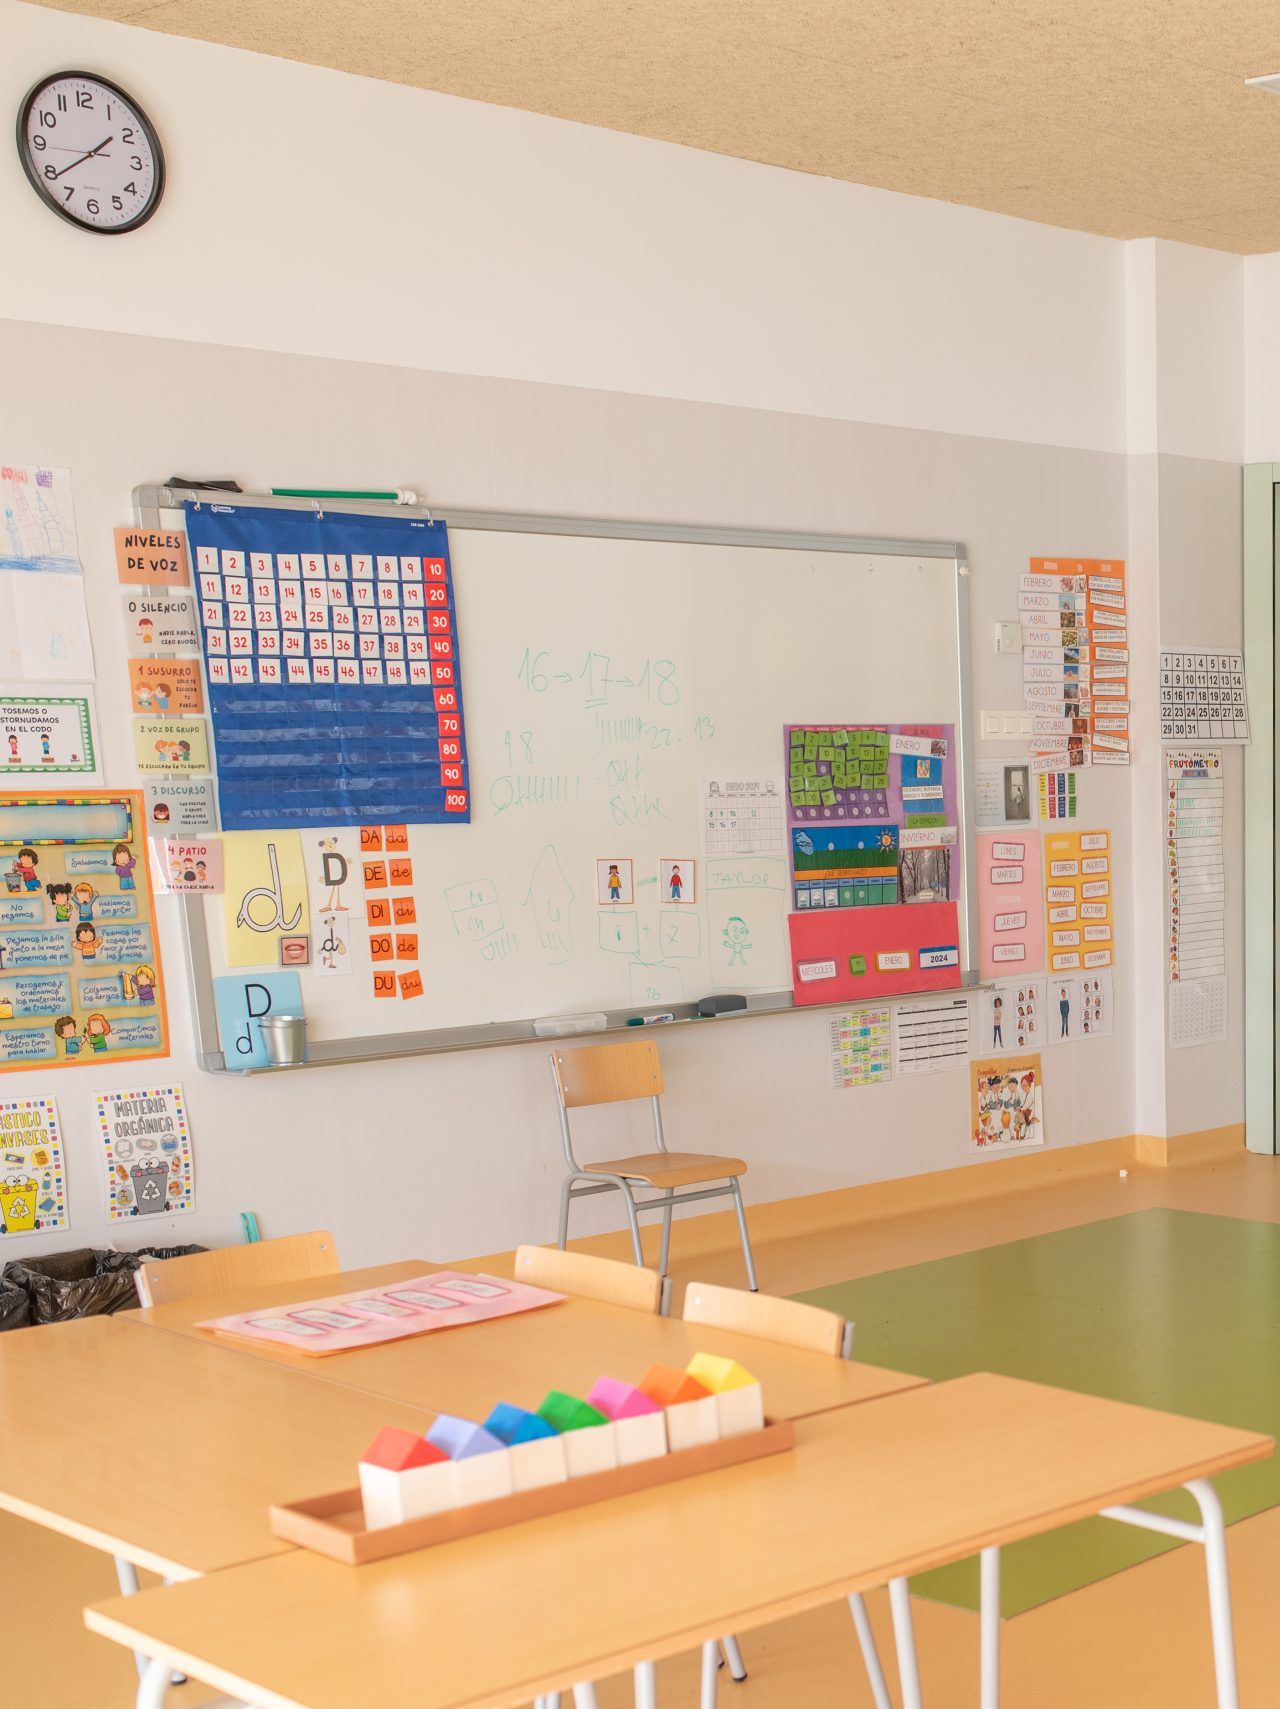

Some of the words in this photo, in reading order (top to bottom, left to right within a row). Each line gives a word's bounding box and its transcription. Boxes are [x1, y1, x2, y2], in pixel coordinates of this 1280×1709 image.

[58, 94, 67, 112] 11
[76, 90, 94, 109] 12
[40, 110, 56, 128] 10
[107, 105, 111, 120] 1
[33, 135, 46, 150] 9
[122, 128, 134, 144] 2
[130, 156, 142, 170] 3
[44, 165, 58, 180] 8
[64, 186, 74, 201] 7
[124, 182, 137, 196] 4
[87, 199, 99, 214] 6
[112, 196, 123, 210] 5
[125, 535, 180, 549] NIVELES
[128, 557, 144, 570] DE
[150, 559, 178, 571] VOZ
[205, 555, 209, 564] 1
[230, 558, 236, 568] 2
[258, 560, 265, 571] 3
[285, 561, 291, 571] 4
[309, 561, 316, 571] 5
[334, 561, 340, 572] 6
[359, 562, 364, 572] 7
[384, 563, 390, 573] 8
[407, 564, 413, 574] 9
[429, 564, 441, 575] 10
[1024, 577, 1052, 588] FEBRERO
[207, 581, 215, 592] 11
[231, 584, 242, 595] 12
[258, 586, 269, 596] 13
[284, 587, 295, 598] 14
[310, 588, 321, 598] 15
[332, 588, 341, 598] 16
[358, 588, 367, 598] 17
[382, 589, 392, 599] 18
[408, 590, 417, 599] 19
[429, 590, 444, 601] 20
[141, 602, 187, 613] SILENCIO
[1024, 596, 1049, 605] MARZO
[432, 617, 447, 627] 30
[1029, 633, 1050, 642] MAYO
[434, 642, 449, 653] 40
[1165, 658, 1168, 666] 1
[1176, 658, 1180, 667] 2
[1188, 658, 1191, 667] 3
[1199, 659, 1203, 667] 4
[1211, 660, 1215, 668] 5
[1222, 660, 1226, 668] 6
[1234, 660, 1237, 669] 7
[138, 667, 143, 675] 1
[148, 667, 191, 676] SUSURRO
[436, 668, 450, 678] 50
[517, 648, 550, 692] 16
[579, 652, 611, 697] 17
[637, 658, 679, 705] 18
[1027, 687, 1056, 695] AGOSTO
[439, 694, 454, 705] 60
[444, 720, 457, 730] 70
[1036, 722, 1065, 730] OCTUBRE
[443, 744, 457, 755] 80
[1033, 755, 1066, 770] DICIEMBRE
[1170, 758, 1219, 768] FRUTÓMETRO
[445, 769, 459, 780] 90
[152, 786, 157, 795] 3
[161, 786, 206, 795] DISCURSO
[447, 795, 465, 806] 100
[361, 830, 380, 844] DA
[169, 846, 174, 854] 4
[179, 847, 206, 855] PATIO
[322, 852, 348, 887] D
[364, 866, 382, 881] DE
[392, 865, 411, 878] de
[237, 844, 302, 932] d
[372, 905, 383, 918] DI
[322, 928, 339, 951] d
[371, 940, 390, 953] DO
[398, 941, 416, 952] do
[885, 956, 902, 964] ENERO
[930, 955, 948, 963] 2024
[375, 977, 393, 991] DU
[245, 984, 272, 1017] D
[236, 1022, 253, 1054] d
[114, 1098, 167, 1117] MATERIA
[114, 1116, 174, 1137] ORGÁNICA
